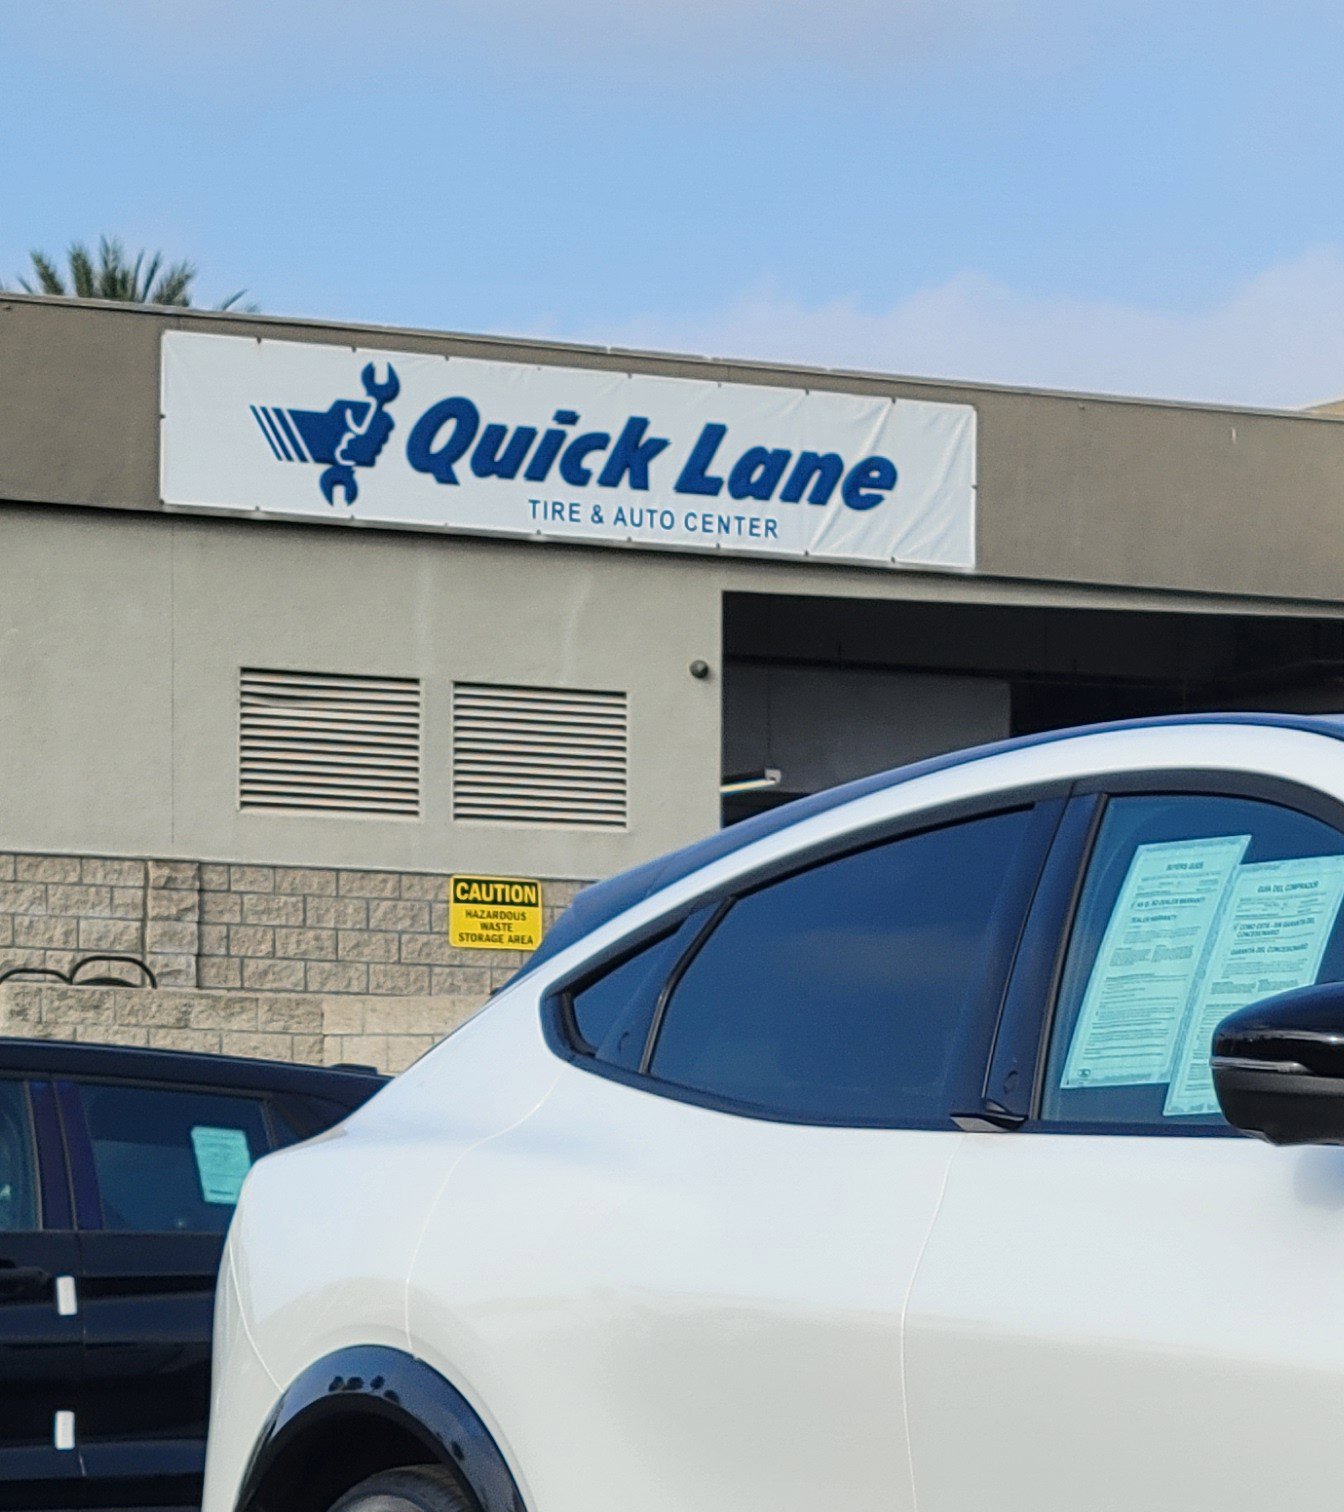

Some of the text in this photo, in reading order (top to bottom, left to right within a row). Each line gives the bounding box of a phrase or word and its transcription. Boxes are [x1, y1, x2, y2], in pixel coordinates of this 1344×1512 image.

[406, 396, 898, 511] Quick Lane
[528, 499, 779, 539] TIRE & AUTO CENTER
[456, 881, 537, 904] CAUTION
[465, 908, 527, 921] HAZARDOUS
[480, 922, 513, 932] WASTE
[458, 932, 534, 945] STORAGE AREA
